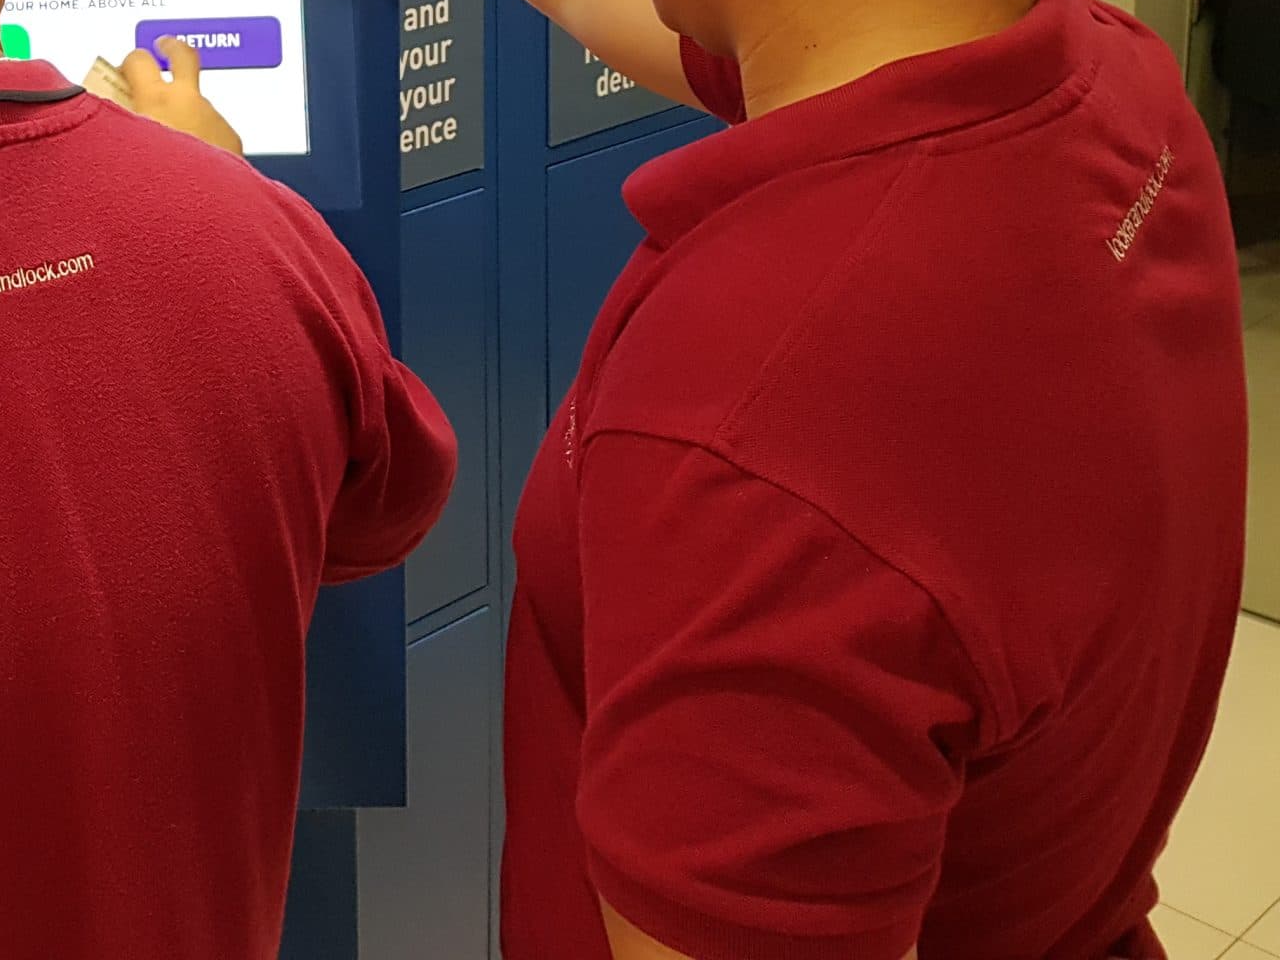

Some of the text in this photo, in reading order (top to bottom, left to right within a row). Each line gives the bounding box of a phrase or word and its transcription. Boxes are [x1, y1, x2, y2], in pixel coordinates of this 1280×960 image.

[5, 1, 34, 12] OUR
[399, 77, 456, 121] your
[400, 116, 457, 153] ence
